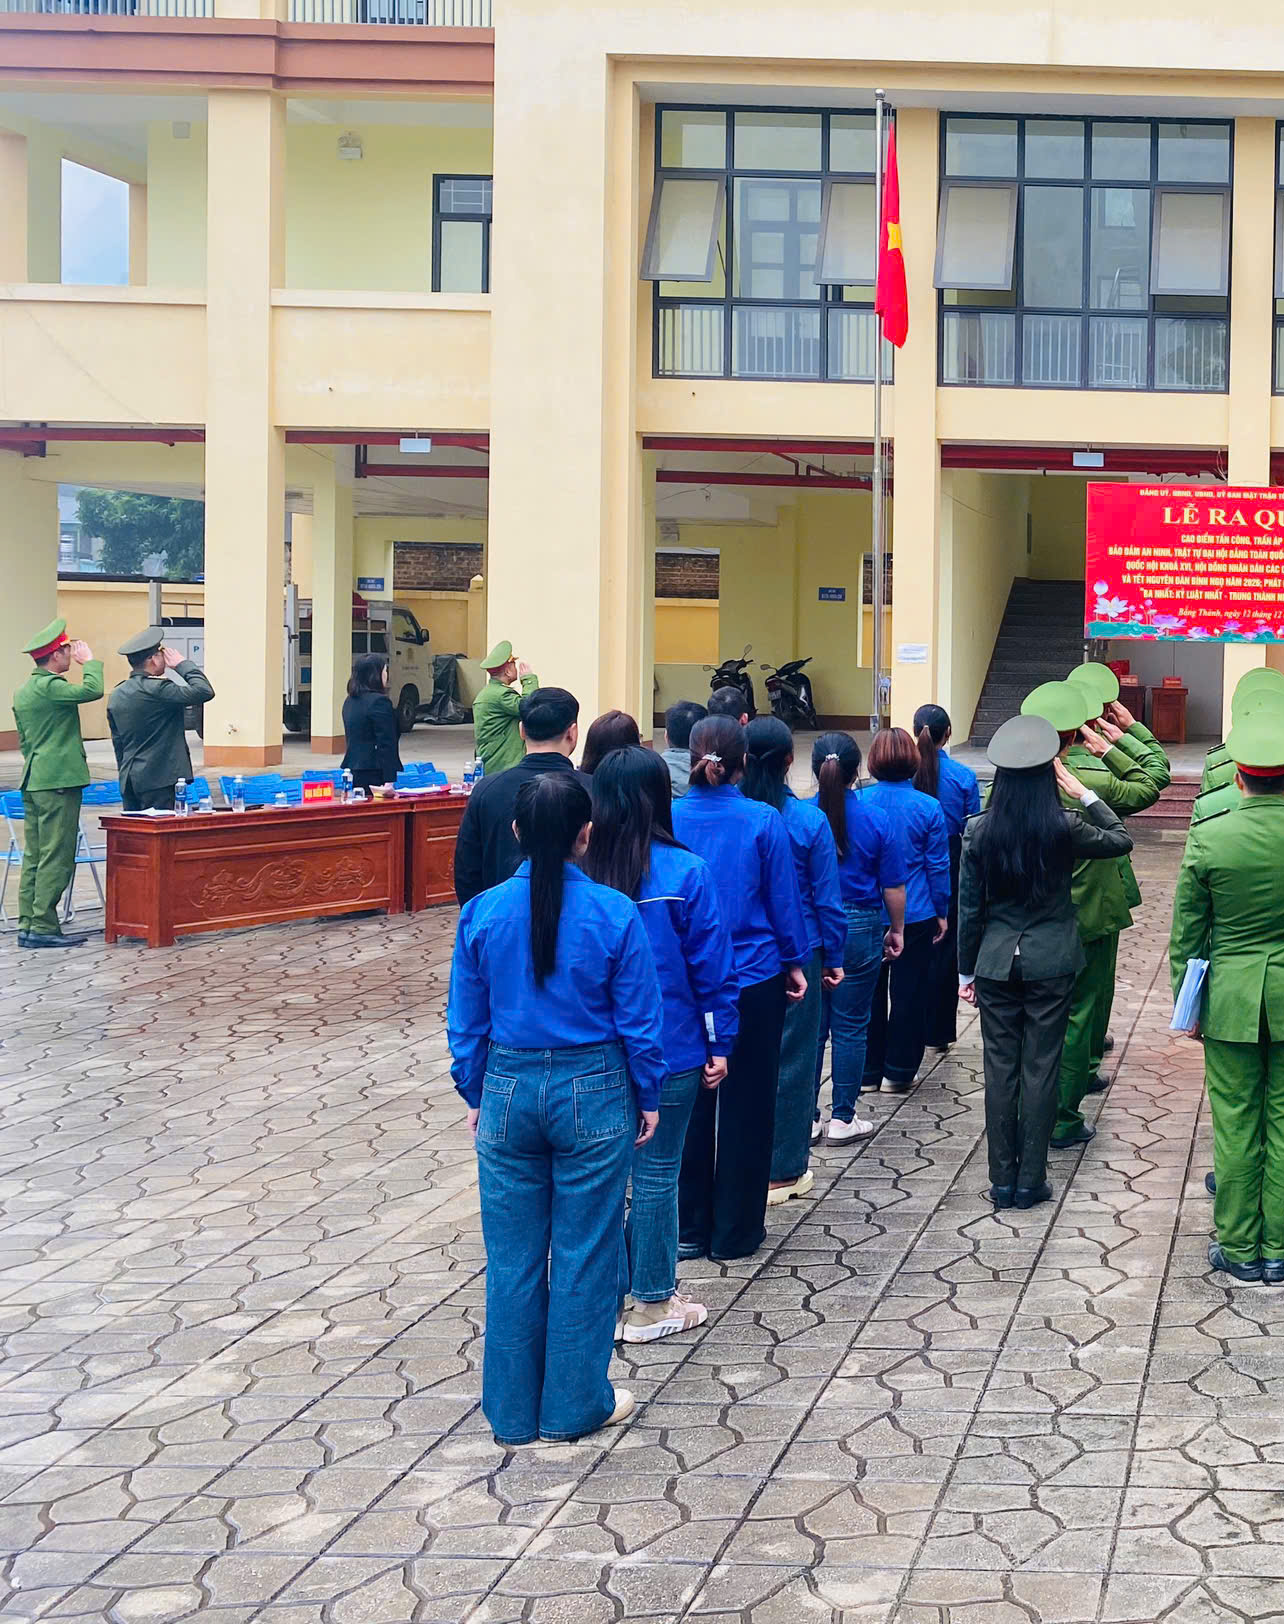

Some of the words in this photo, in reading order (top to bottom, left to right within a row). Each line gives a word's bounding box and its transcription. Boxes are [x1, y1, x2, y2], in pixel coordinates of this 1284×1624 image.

[1163, 503, 1200, 524] LỄ
[1208, 508, 1248, 526] RA
[1180, 535, 1196, 543] CAO
[1196, 533, 1214, 544] ĐIỂM
[1216, 534, 1230, 544] TẤN
[1254, 535, 1272, 545] TRẤN
[1272, 535, 1284, 546] ÁP
[1108, 545, 1124, 556] BẢO
[1140, 548, 1152, 556] AN
[1174, 547, 1192, 559] TRẬT
[1192, 549, 1202, 559] TỰ
[1202, 549, 1214, 559] ĐẠI
[1216, 548, 1228, 560] HỘI
[1228, 548, 1248, 559] ĐẢNG
[1250, 549, 1268, 559] TOÀN
[1126, 560, 1144, 570] QUỐC
[1146, 561, 1158, 572] HỘI
[1194, 562, 1208, 574] HỘI
[1208, 562, 1228, 573] ĐỒNG
[1228, 563, 1248, 573] NHÂN
[1248, 563, 1264, 574] DÂN
[1266, 564, 1280, 574] CÁC
[1122, 574, 1132, 584] VÀ
[1132, 574, 1146, 584] TẾT
[1146, 574, 1174, 585] NGUYÊN
[1174, 575, 1190, 585] ĐÁN
[1190, 575, 1208, 586] BÍNH
[1210, 578, 1224, 588] NGỌ
[1226, 576, 1242, 586] NĂM
[1264, 577, 1282, 588] PHÁT
[1154, 588, 1174, 599] NHẤT:
[1186, 589, 1204, 601] LUẬT
[1204, 590, 1222, 600] NHẤT
[1228, 592, 1252, 600] TRUNG
[1254, 591, 1276, 601] THÀNH
[1224, 610, 1240, 619] ngày
[1252, 610, 1272, 620] tháng
